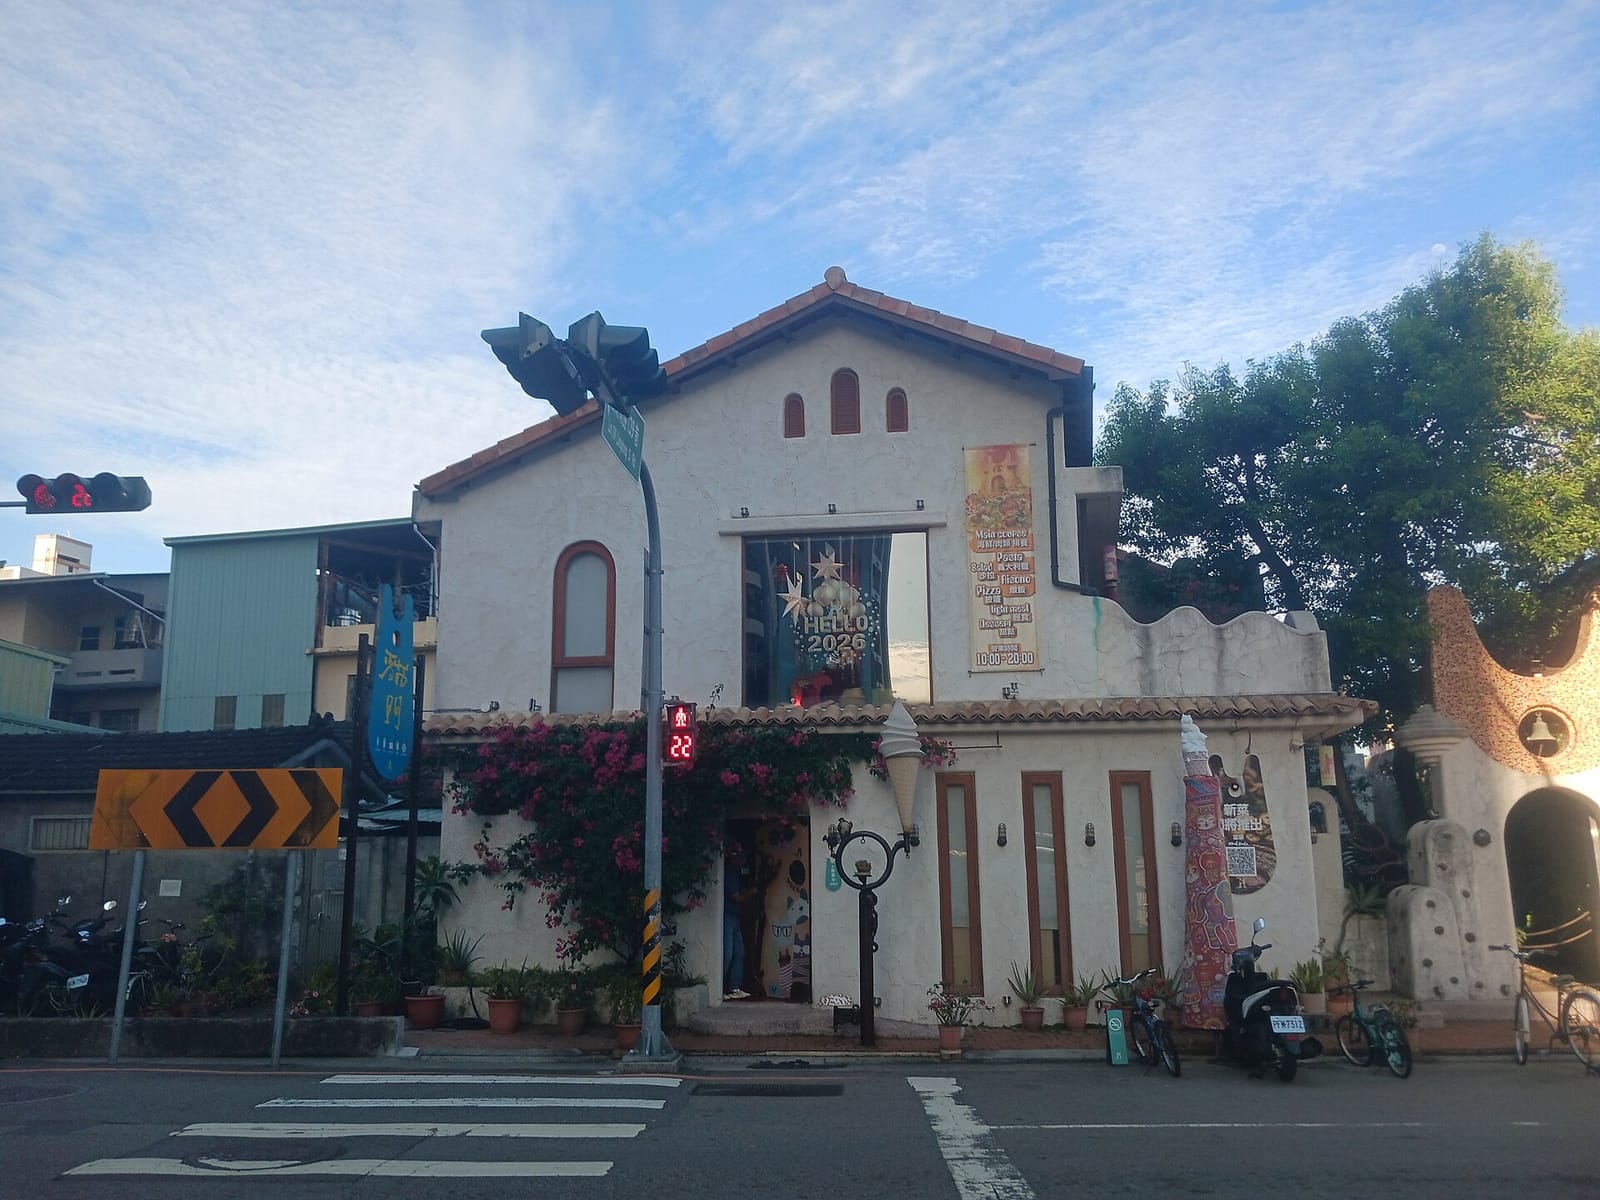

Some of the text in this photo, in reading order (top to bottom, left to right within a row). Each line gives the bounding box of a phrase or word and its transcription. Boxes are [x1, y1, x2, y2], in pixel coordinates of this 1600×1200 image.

[975, 530, 996, 539] Main
[976, 586, 1001, 596] Pizza
[804, 614, 869, 634] HELLO
[808, 632, 867, 653] 2026
[670, 735, 692, 758] 22
